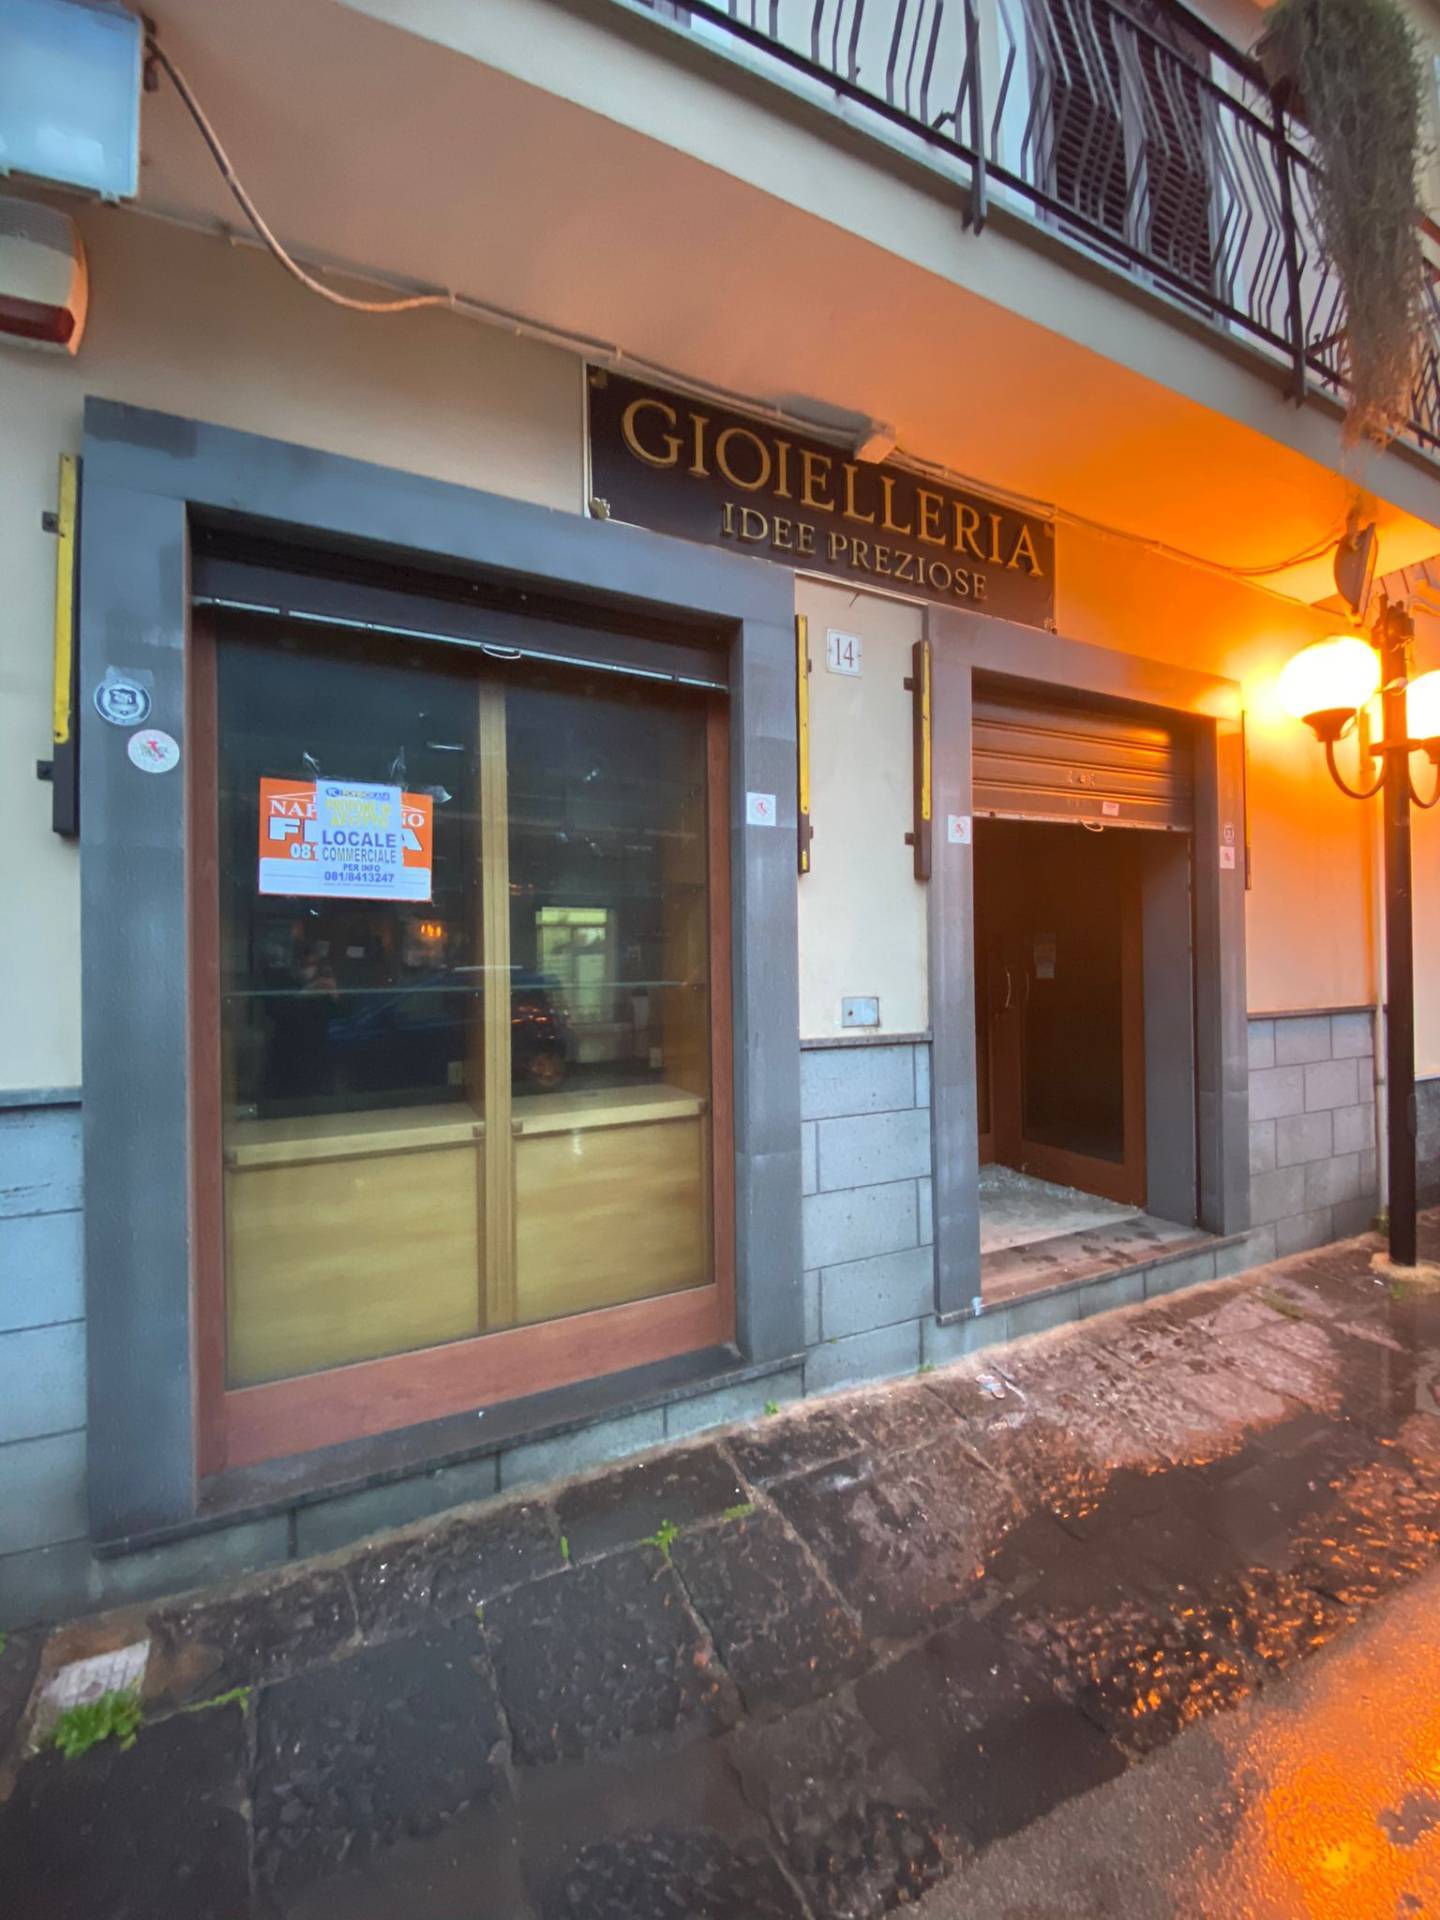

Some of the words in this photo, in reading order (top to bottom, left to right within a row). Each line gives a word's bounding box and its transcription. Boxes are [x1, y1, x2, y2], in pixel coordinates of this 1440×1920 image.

[622, 398, 1044, 577] GIOIELLERIA
[722, 502, 816, 555] IDEE
[828, 531, 988, 600] PREZIOSE
[834, 637, 855, 669] 14
[322, 830, 396, 848] LOCALE
[322, 847, 396, 864] COMMERCIALE
[324, 871, 395, 883] 081/8413247
[343, 863, 360, 872] PER
[360, 863, 381, 873] INFO
